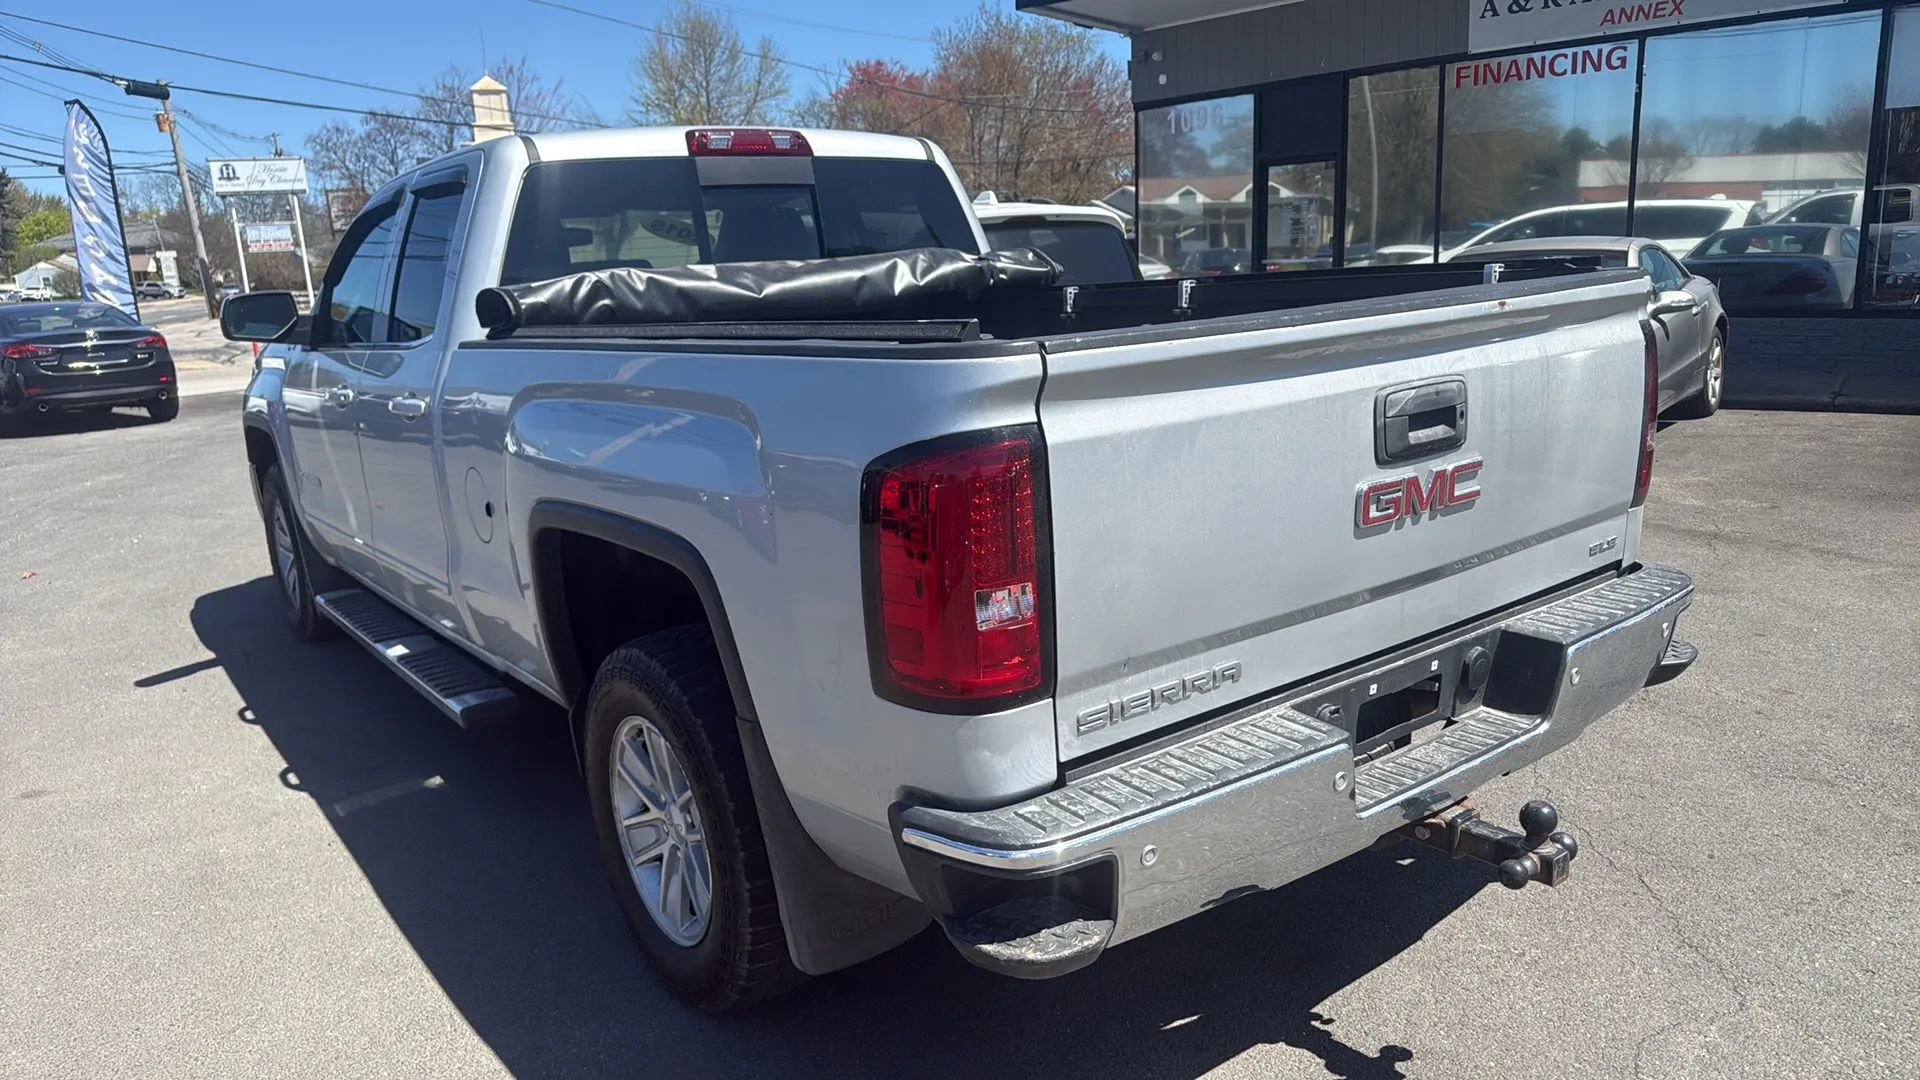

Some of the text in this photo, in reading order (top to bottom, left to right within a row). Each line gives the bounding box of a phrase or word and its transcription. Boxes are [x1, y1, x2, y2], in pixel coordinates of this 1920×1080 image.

[1479, 0, 1500, 19] A
[1600, 0, 1686, 26] ANNEX
[1456, 45, 1628, 88] FINANCING
[1167, 102, 1224, 135] 1096
[1356, 456, 1484, 529] GMC
[1589, 536, 1618, 558] SLE
[1076, 660, 1243, 737] SIERRA
